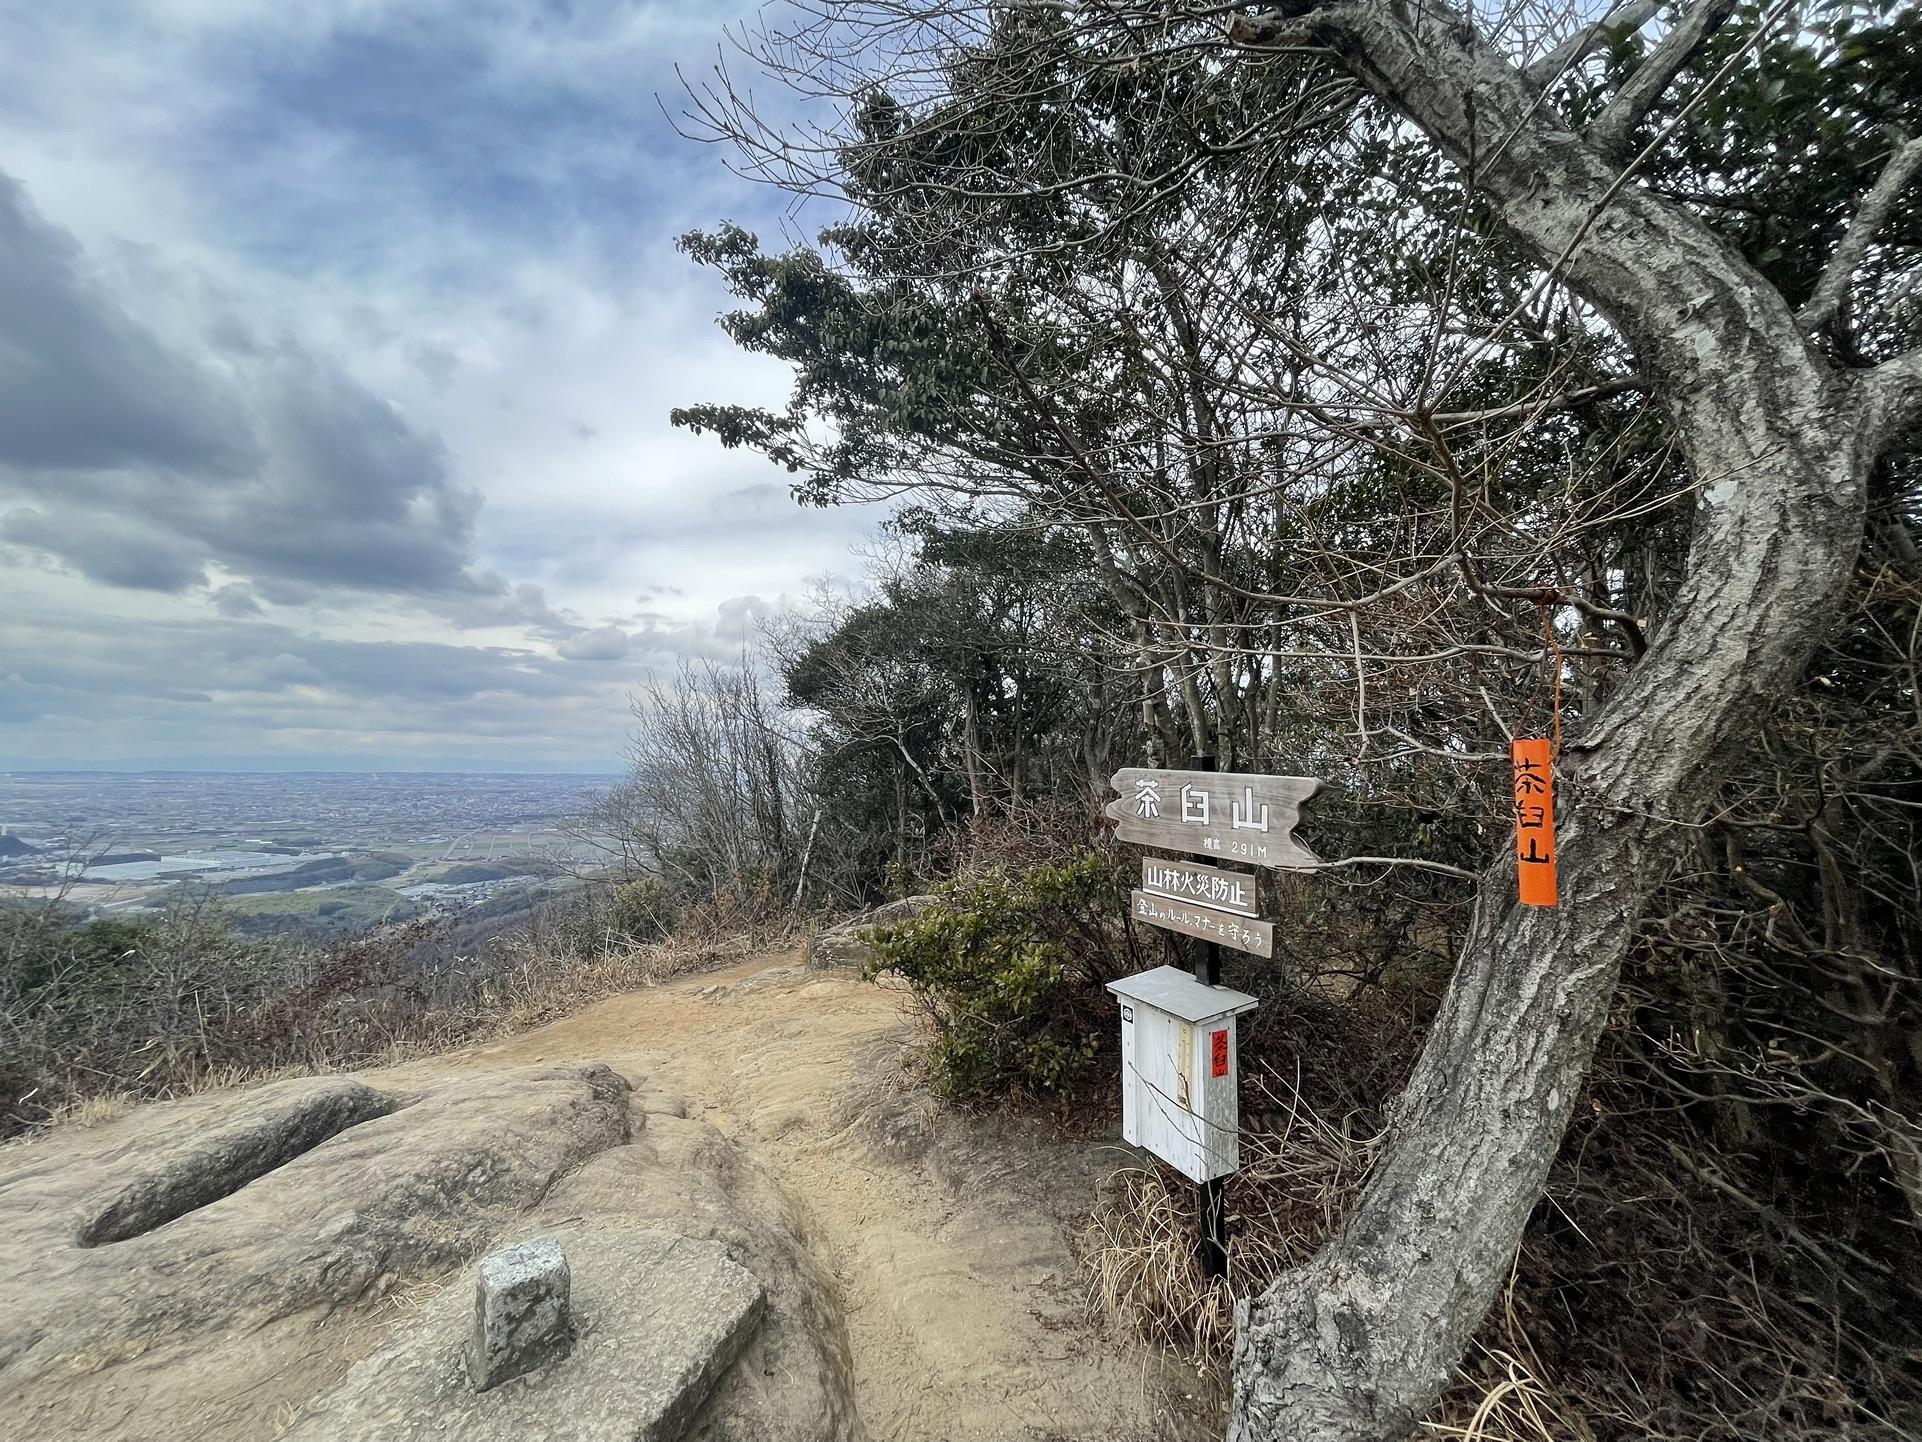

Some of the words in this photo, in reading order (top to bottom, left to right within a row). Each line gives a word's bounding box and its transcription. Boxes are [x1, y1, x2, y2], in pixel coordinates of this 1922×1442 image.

[1134, 779, 1269, 833] 茶臼山
[1514, 757, 1550, 864] 茶臼山
[1231, 841, 1267, 858] 291M
[1147, 866, 1248, 907] 山林火災防止
